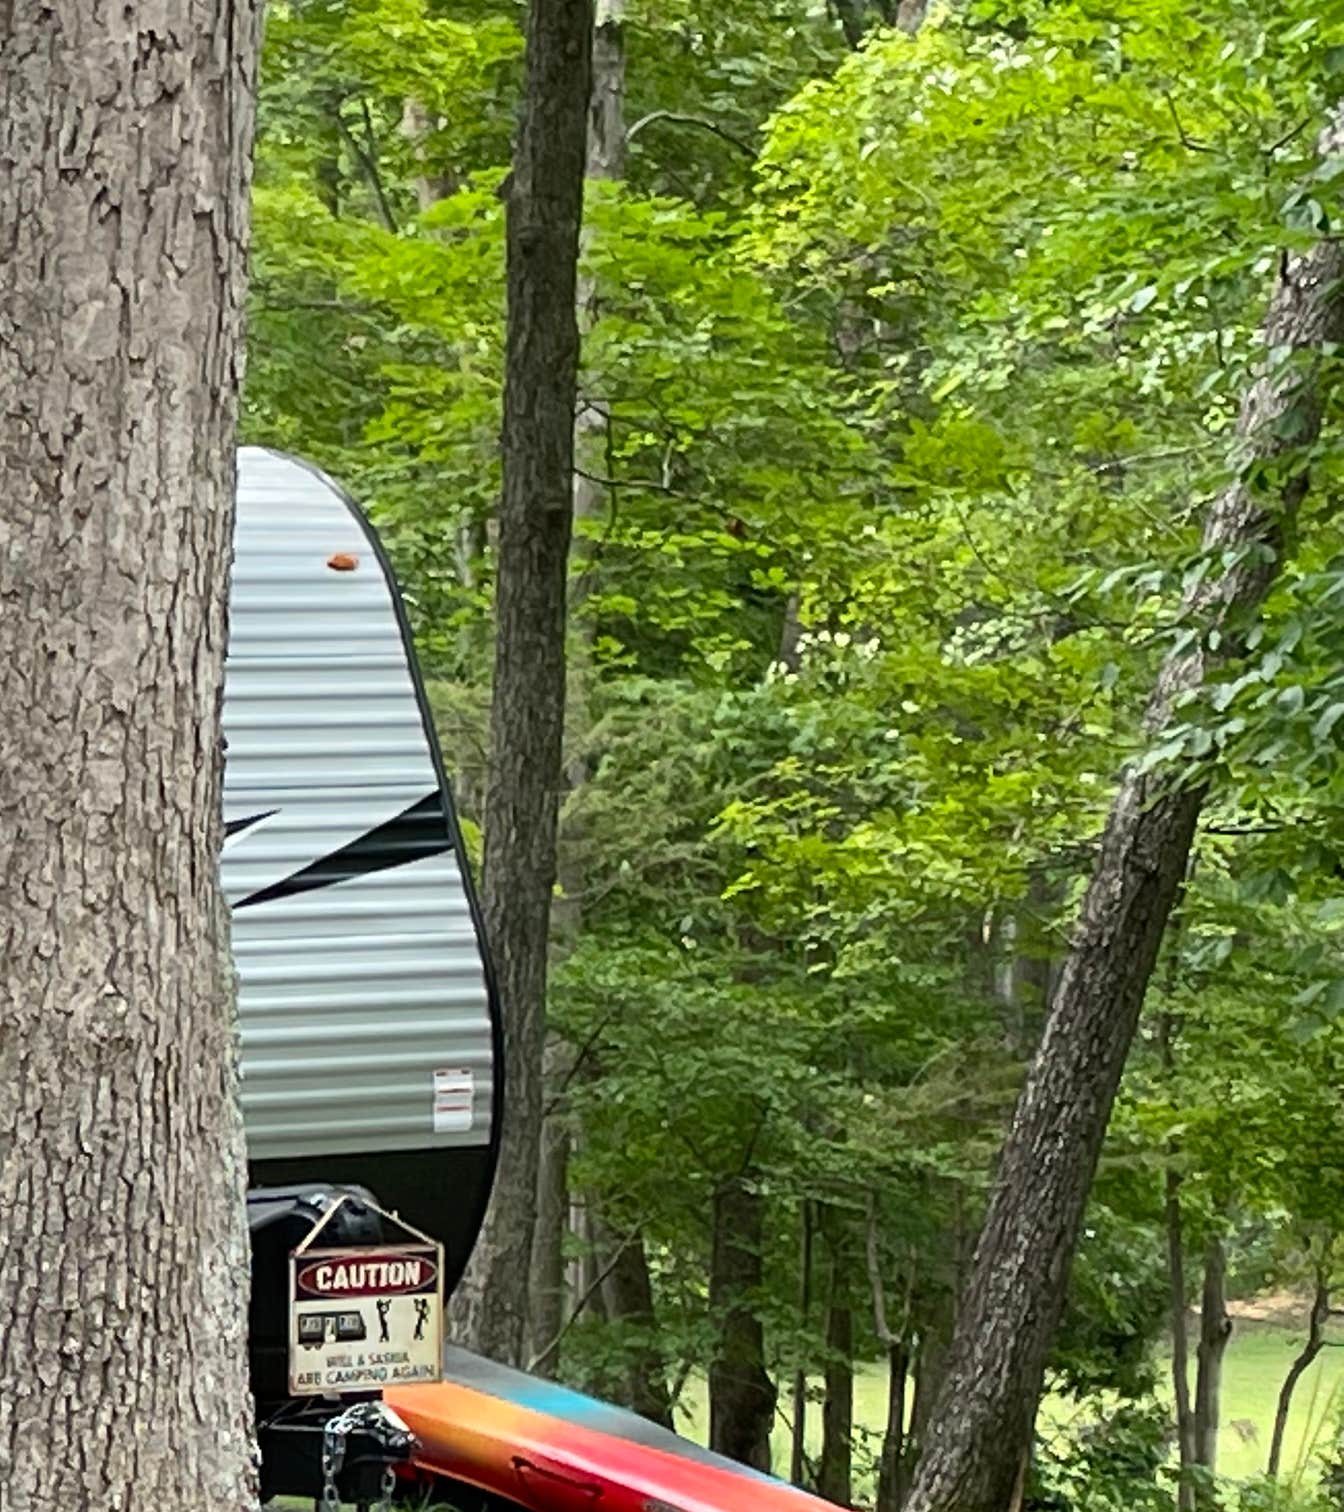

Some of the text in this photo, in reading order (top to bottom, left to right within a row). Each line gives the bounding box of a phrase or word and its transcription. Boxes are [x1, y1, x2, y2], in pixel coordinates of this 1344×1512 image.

[316, 1261, 421, 1290] CAUTION
[298, 1364, 435, 1386] ARE CAMPING AGAIN
